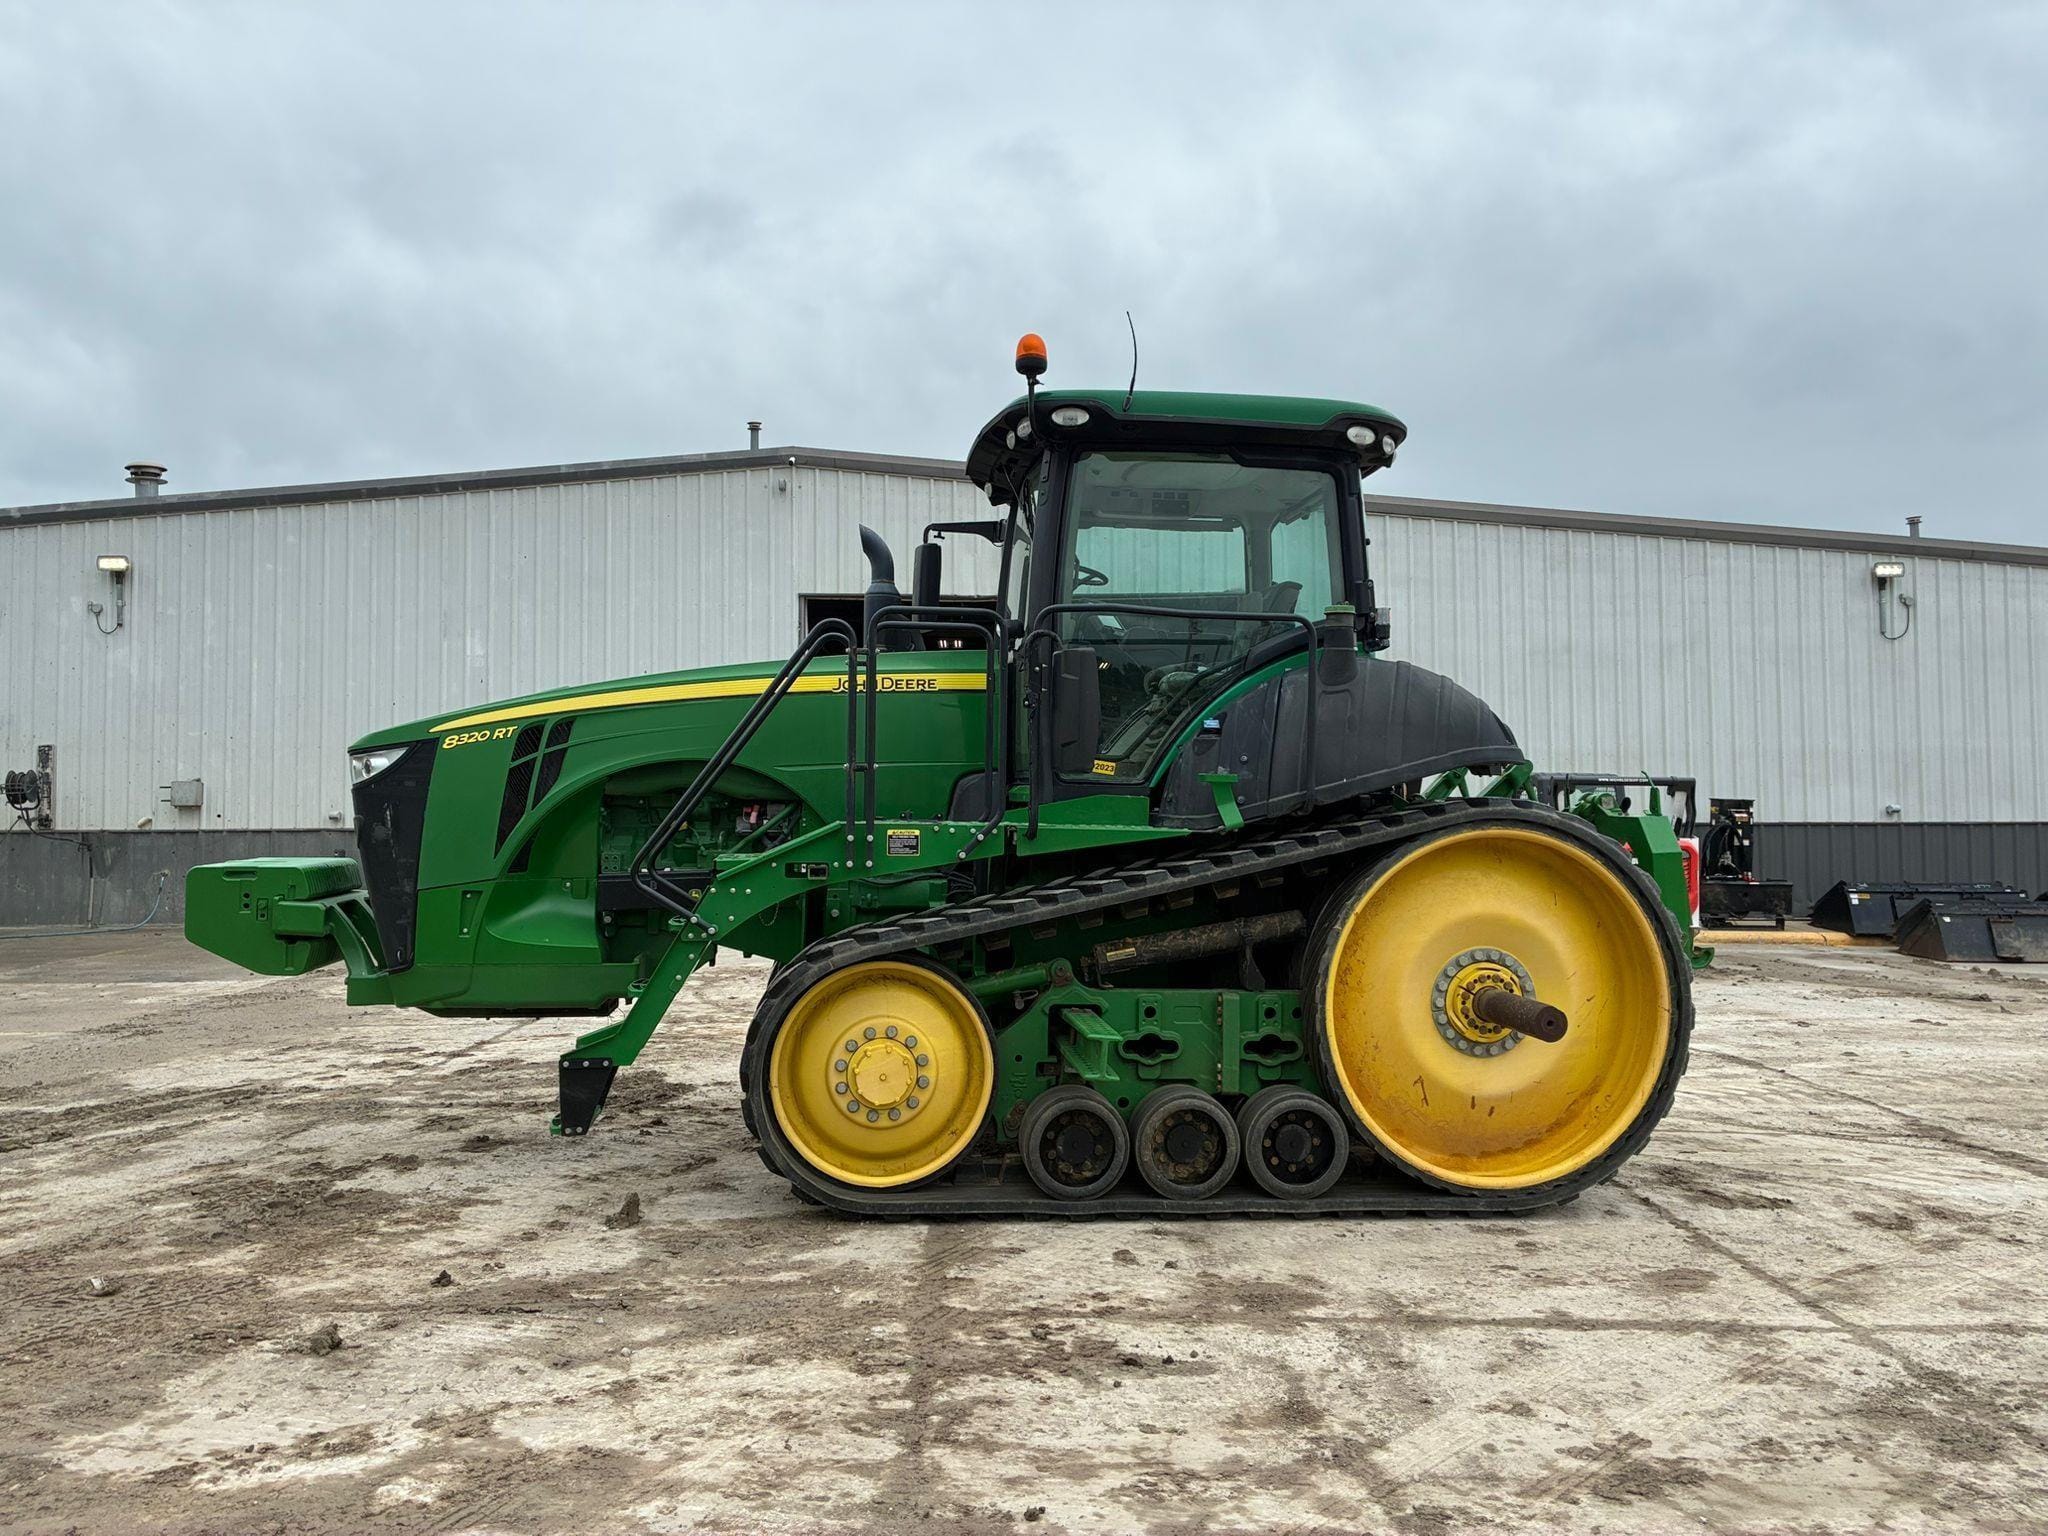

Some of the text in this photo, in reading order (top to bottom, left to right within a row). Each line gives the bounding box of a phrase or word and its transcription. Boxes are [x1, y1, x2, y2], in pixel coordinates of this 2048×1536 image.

[832, 677, 938, 691] JOH DEERE
[442, 726, 519, 749] 8320 RT
[1095, 763, 1115, 772] 2023
